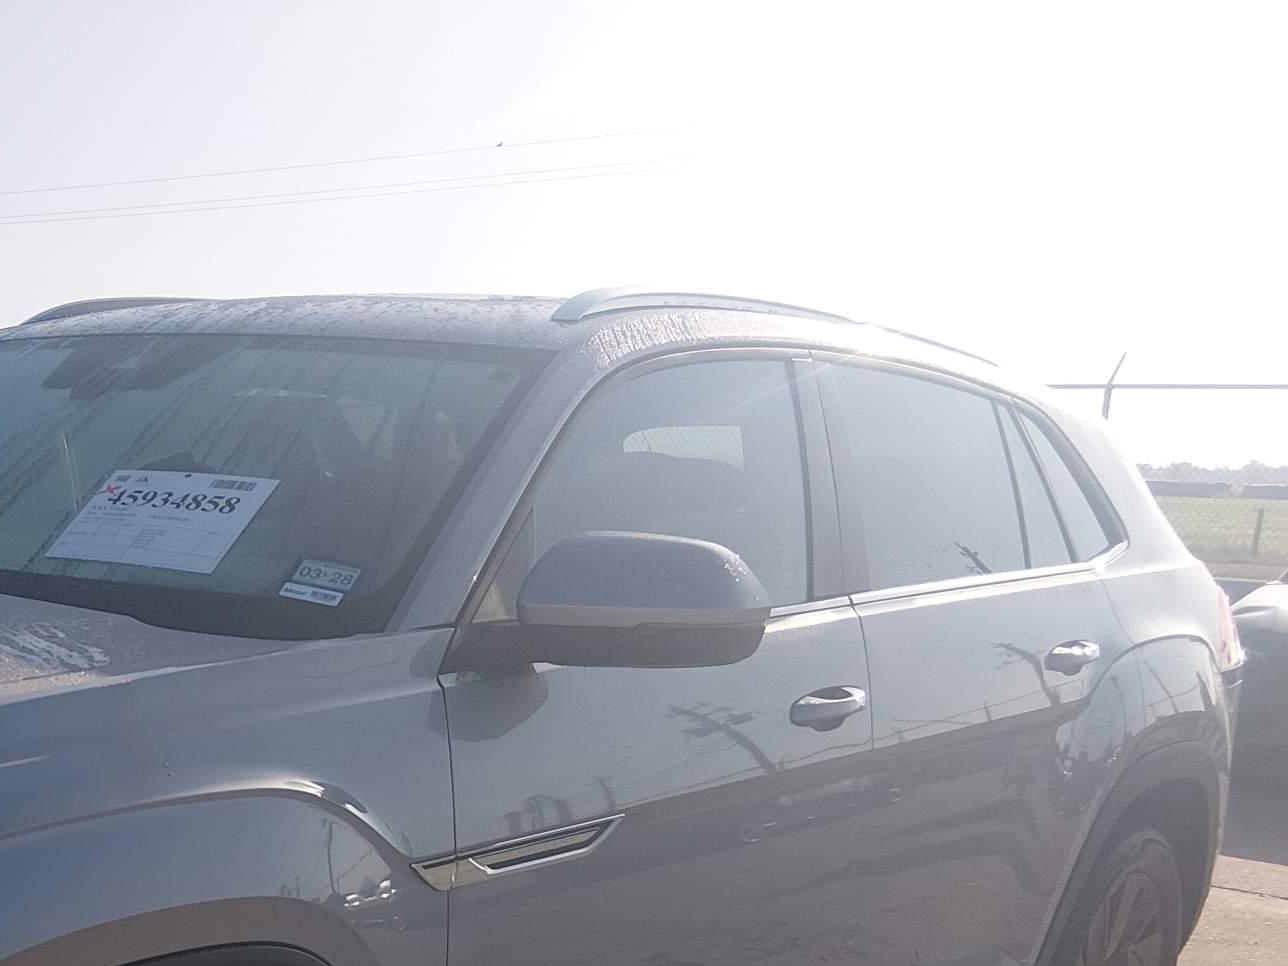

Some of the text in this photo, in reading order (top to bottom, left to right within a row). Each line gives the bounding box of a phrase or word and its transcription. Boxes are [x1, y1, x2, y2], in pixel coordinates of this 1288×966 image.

[106, 489, 242, 515] 45934858
[298, 566, 323, 580] 03
[328, 571, 355, 586] 28
